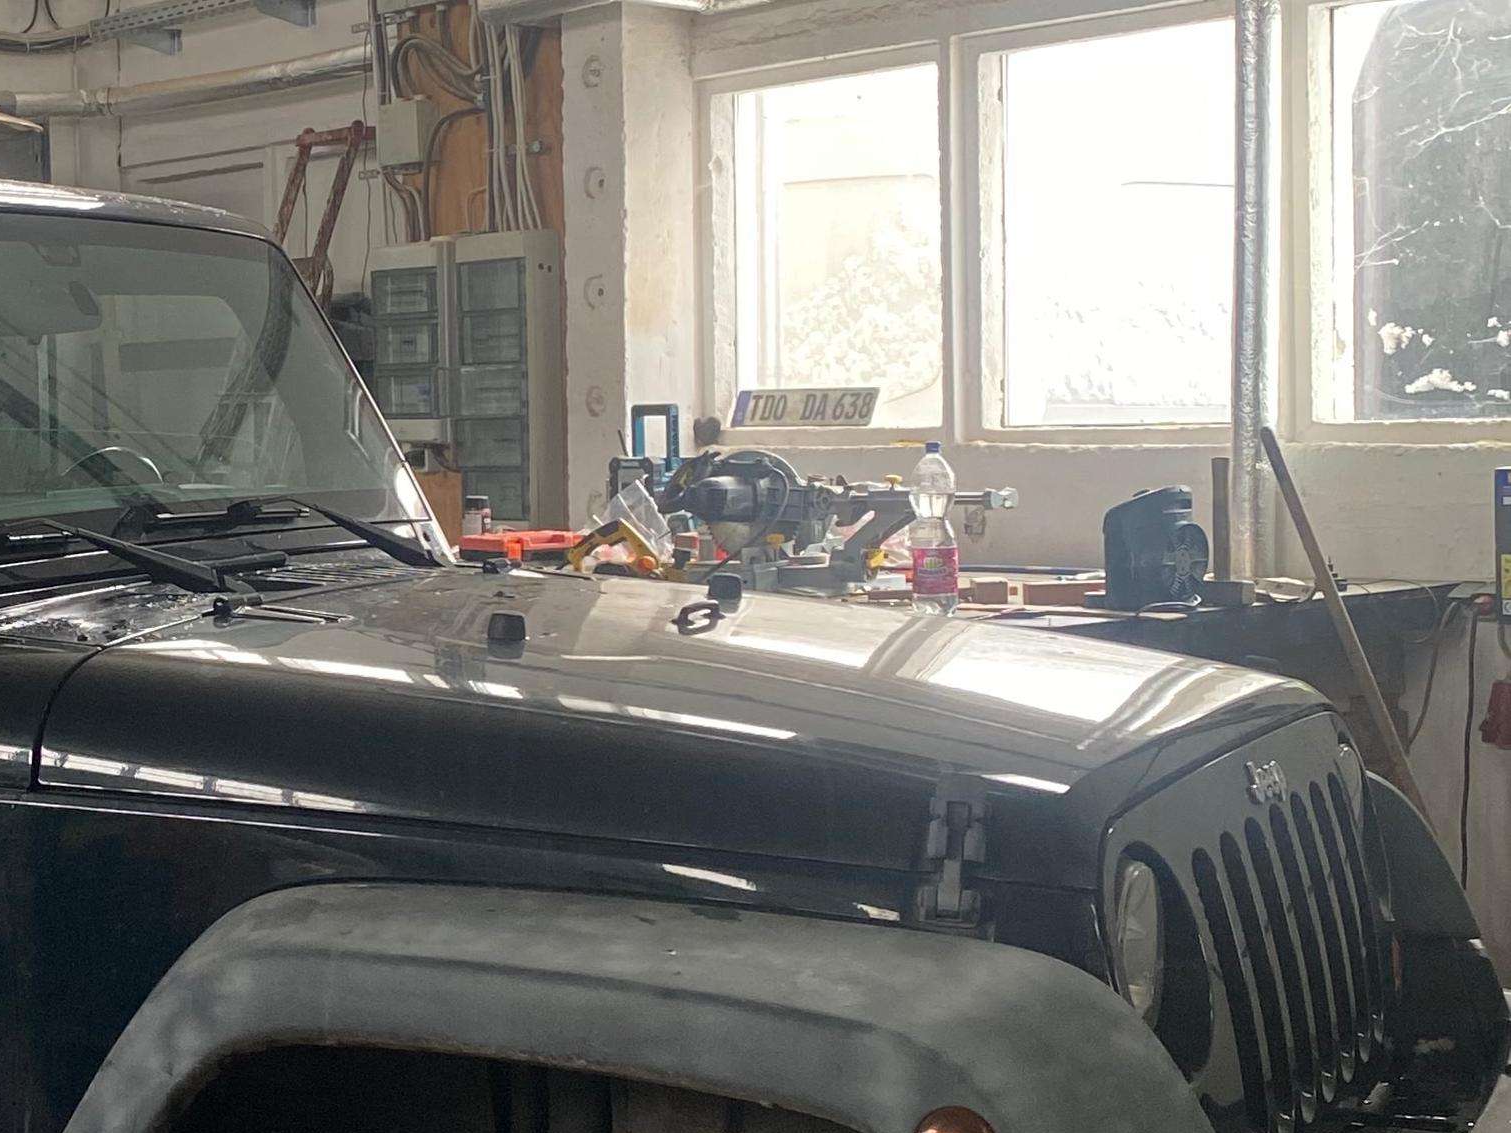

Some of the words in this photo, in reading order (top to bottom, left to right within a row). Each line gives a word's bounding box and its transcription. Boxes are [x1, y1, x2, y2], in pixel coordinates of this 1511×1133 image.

[750, 394, 788, 421] TDO
[799, 393, 829, 421] DA
[831, 392, 875, 421] 638
